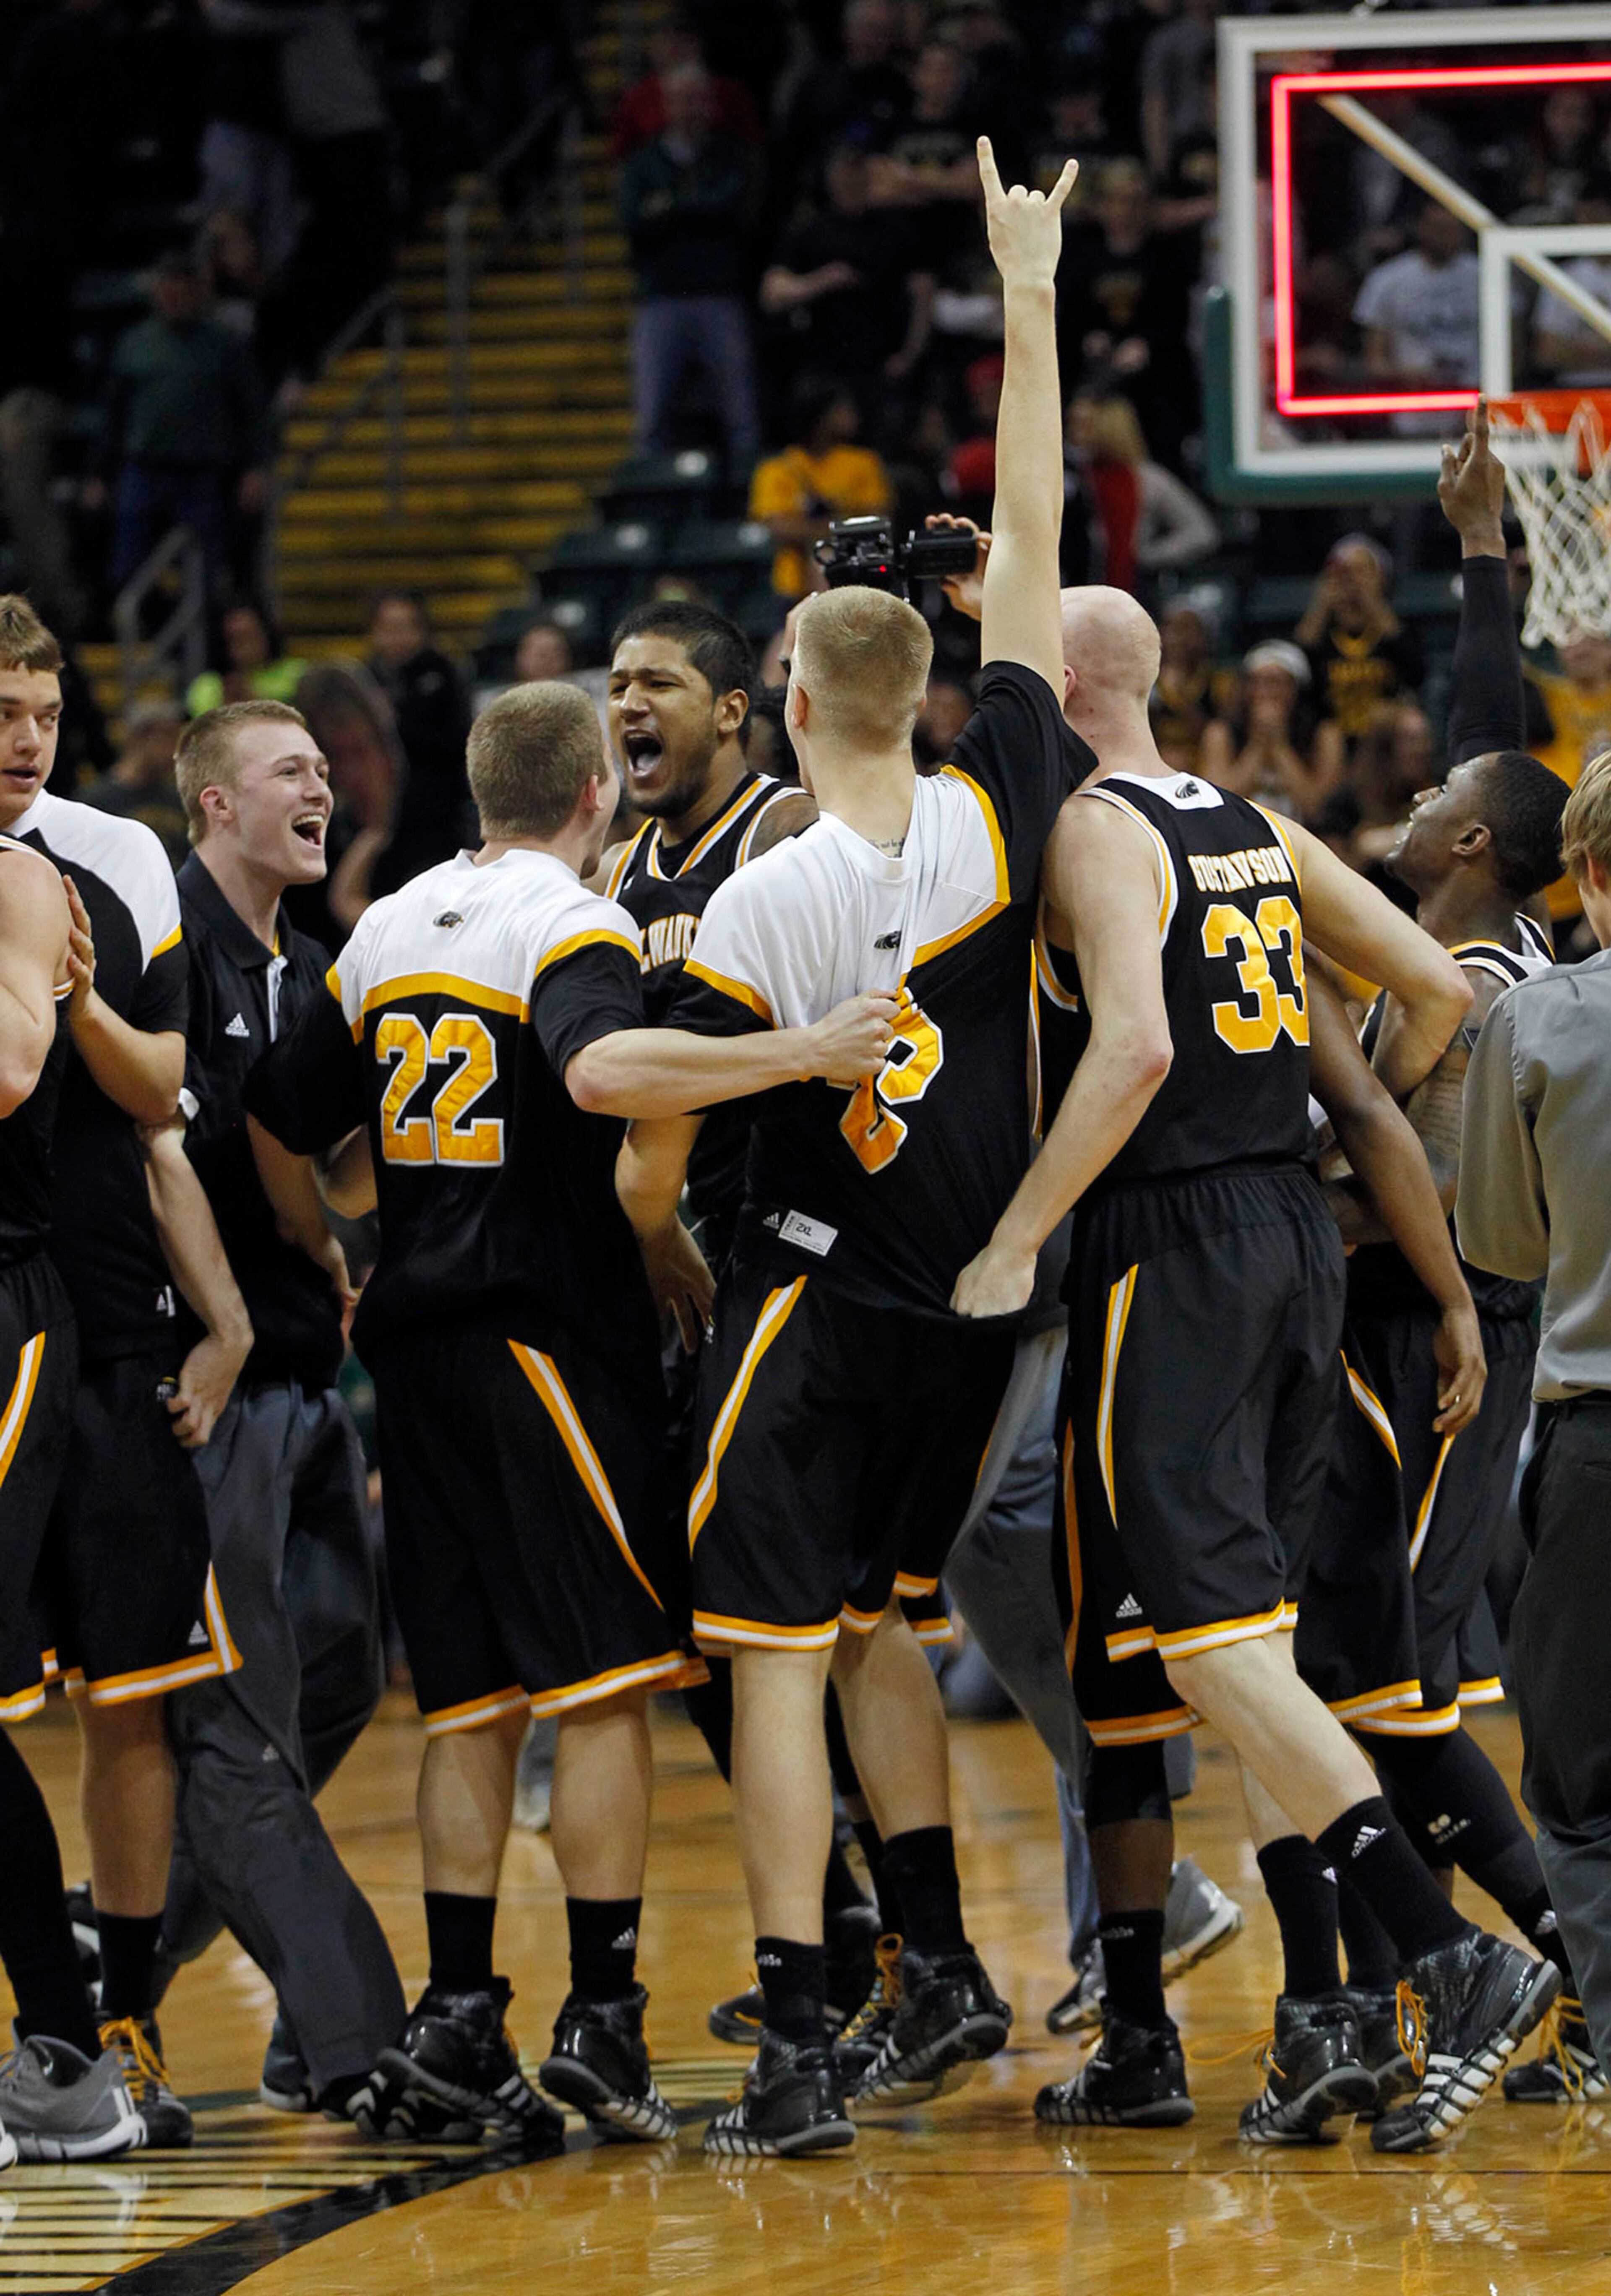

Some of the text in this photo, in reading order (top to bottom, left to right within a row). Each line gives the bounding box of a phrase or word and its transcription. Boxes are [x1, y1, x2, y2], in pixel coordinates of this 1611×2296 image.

[1187, 846, 1292, 893] GUSTAVSON
[639, 913, 701, 975] LWAUK
[1201, 895, 1310, 1054] 33
[375, 1013, 505, 1167] 22
